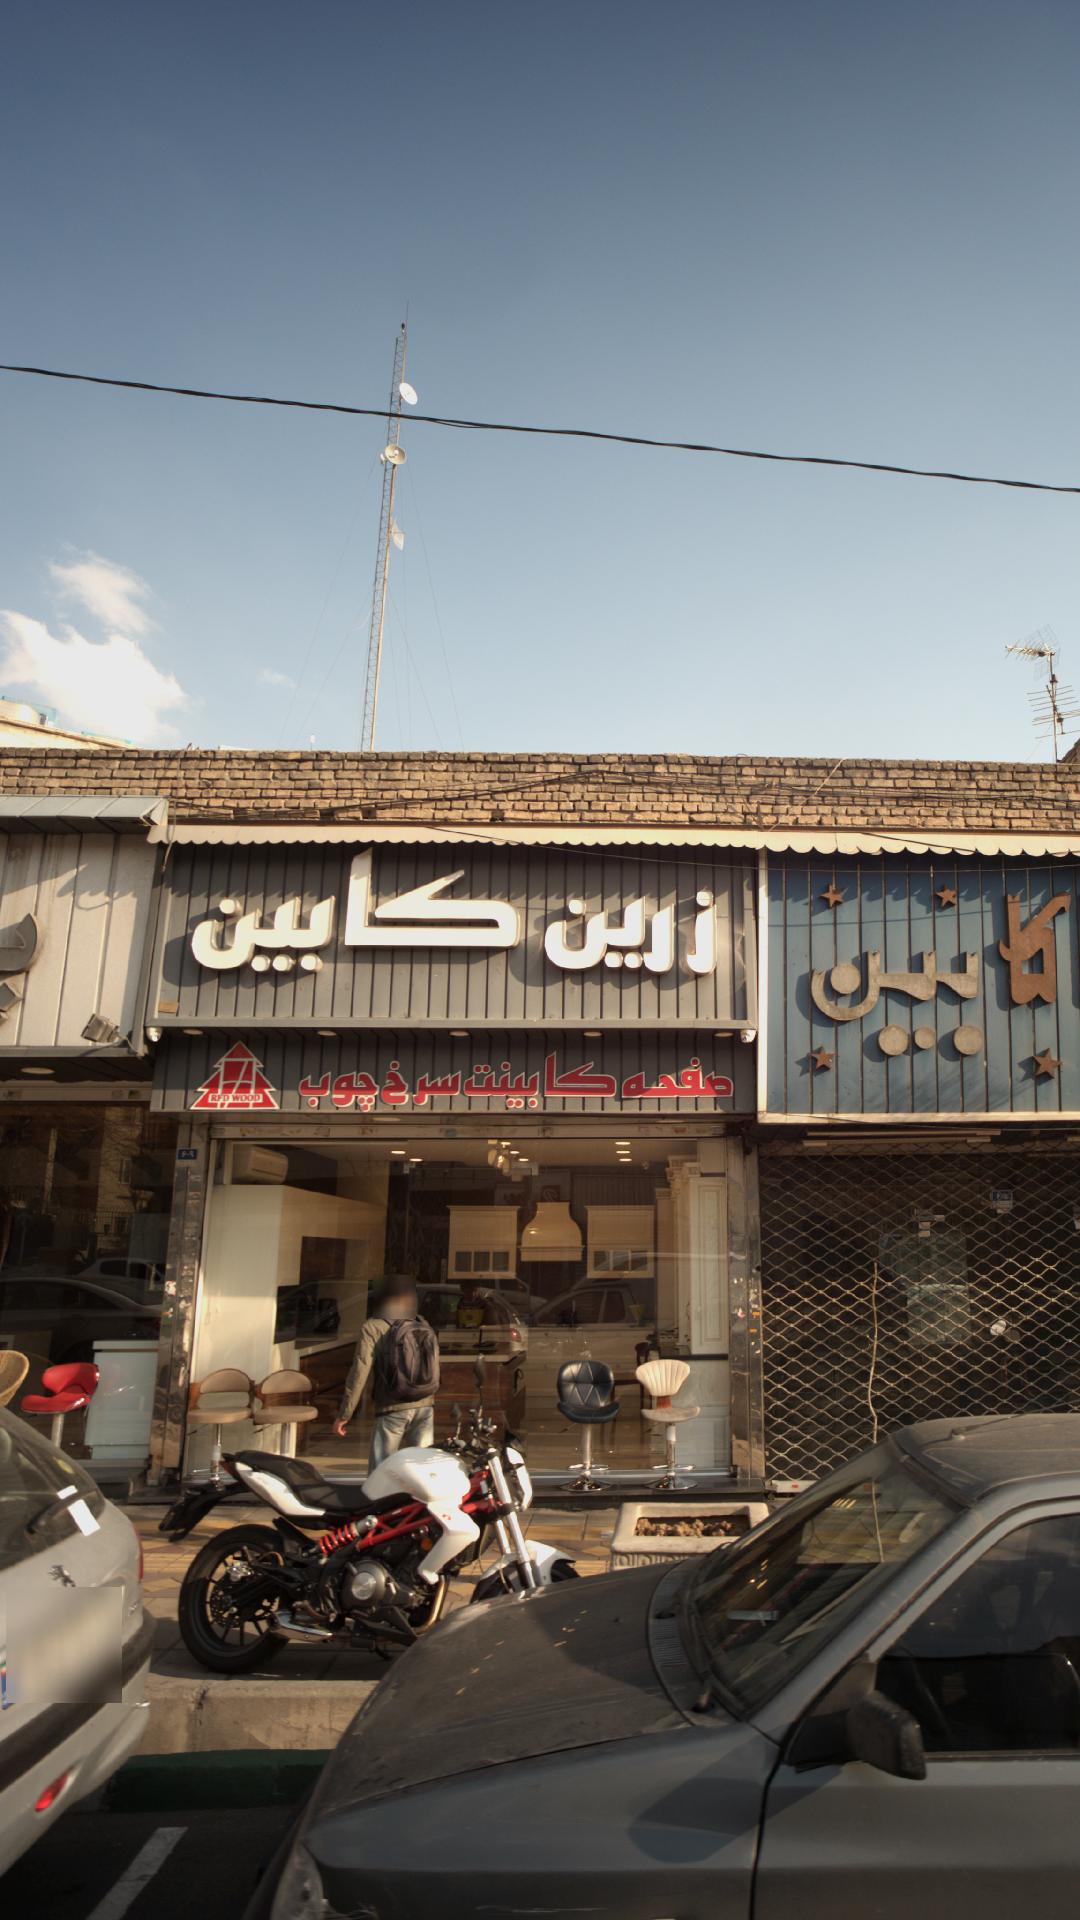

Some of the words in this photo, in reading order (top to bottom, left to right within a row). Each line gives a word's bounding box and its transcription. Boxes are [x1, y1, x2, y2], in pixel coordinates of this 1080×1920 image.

[191, 848, 521, 973] کابین
[544, 889, 718, 974] زرین
[210, 1093, 230, 1102] RED
[231, 1093, 261, 1102] WOOD
[299, 1071, 380, 1112] چوب
[382, 1061, 461, 1105] سرخ
[464, 1051, 617, 1109] کابینت
[622, 1057, 733, 1098] صفحه
